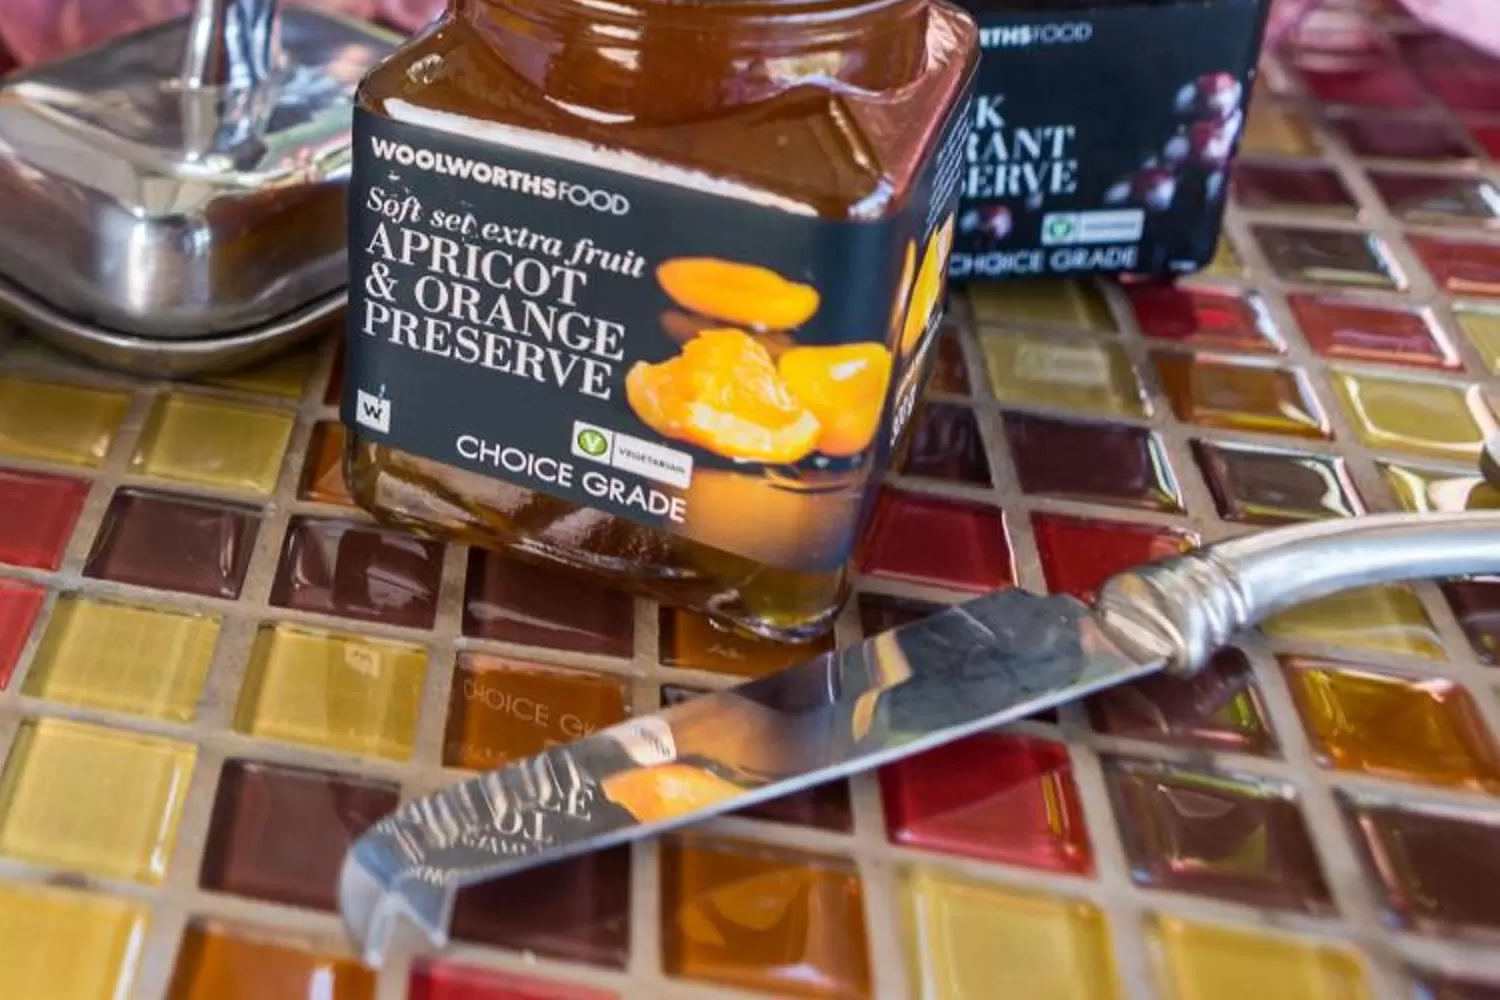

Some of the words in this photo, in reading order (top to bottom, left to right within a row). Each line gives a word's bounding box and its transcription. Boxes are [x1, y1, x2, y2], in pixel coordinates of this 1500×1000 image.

[979, 22, 1093, 48] RTHSFOOD
[371, 136, 631, 216] WOOLWORTHSFOOD
[960, 159, 1078, 197] ERVE
[365, 221, 588, 307] APRICOT
[366, 186, 423, 223] Soft
[429, 209, 475, 235] set
[481, 221, 564, 257] extra
[563, 238, 647, 278] fruit
[949, 250, 1045, 277] CHOICE
[1049, 246, 1138, 273] GRADE
[361, 297, 613, 401] PRESERVE
[365, 261, 399, 303] &
[414, 274, 627, 362] ORANGE
[455, 435, 574, 488] CHOICE
[581, 471, 688, 523] GRADE
